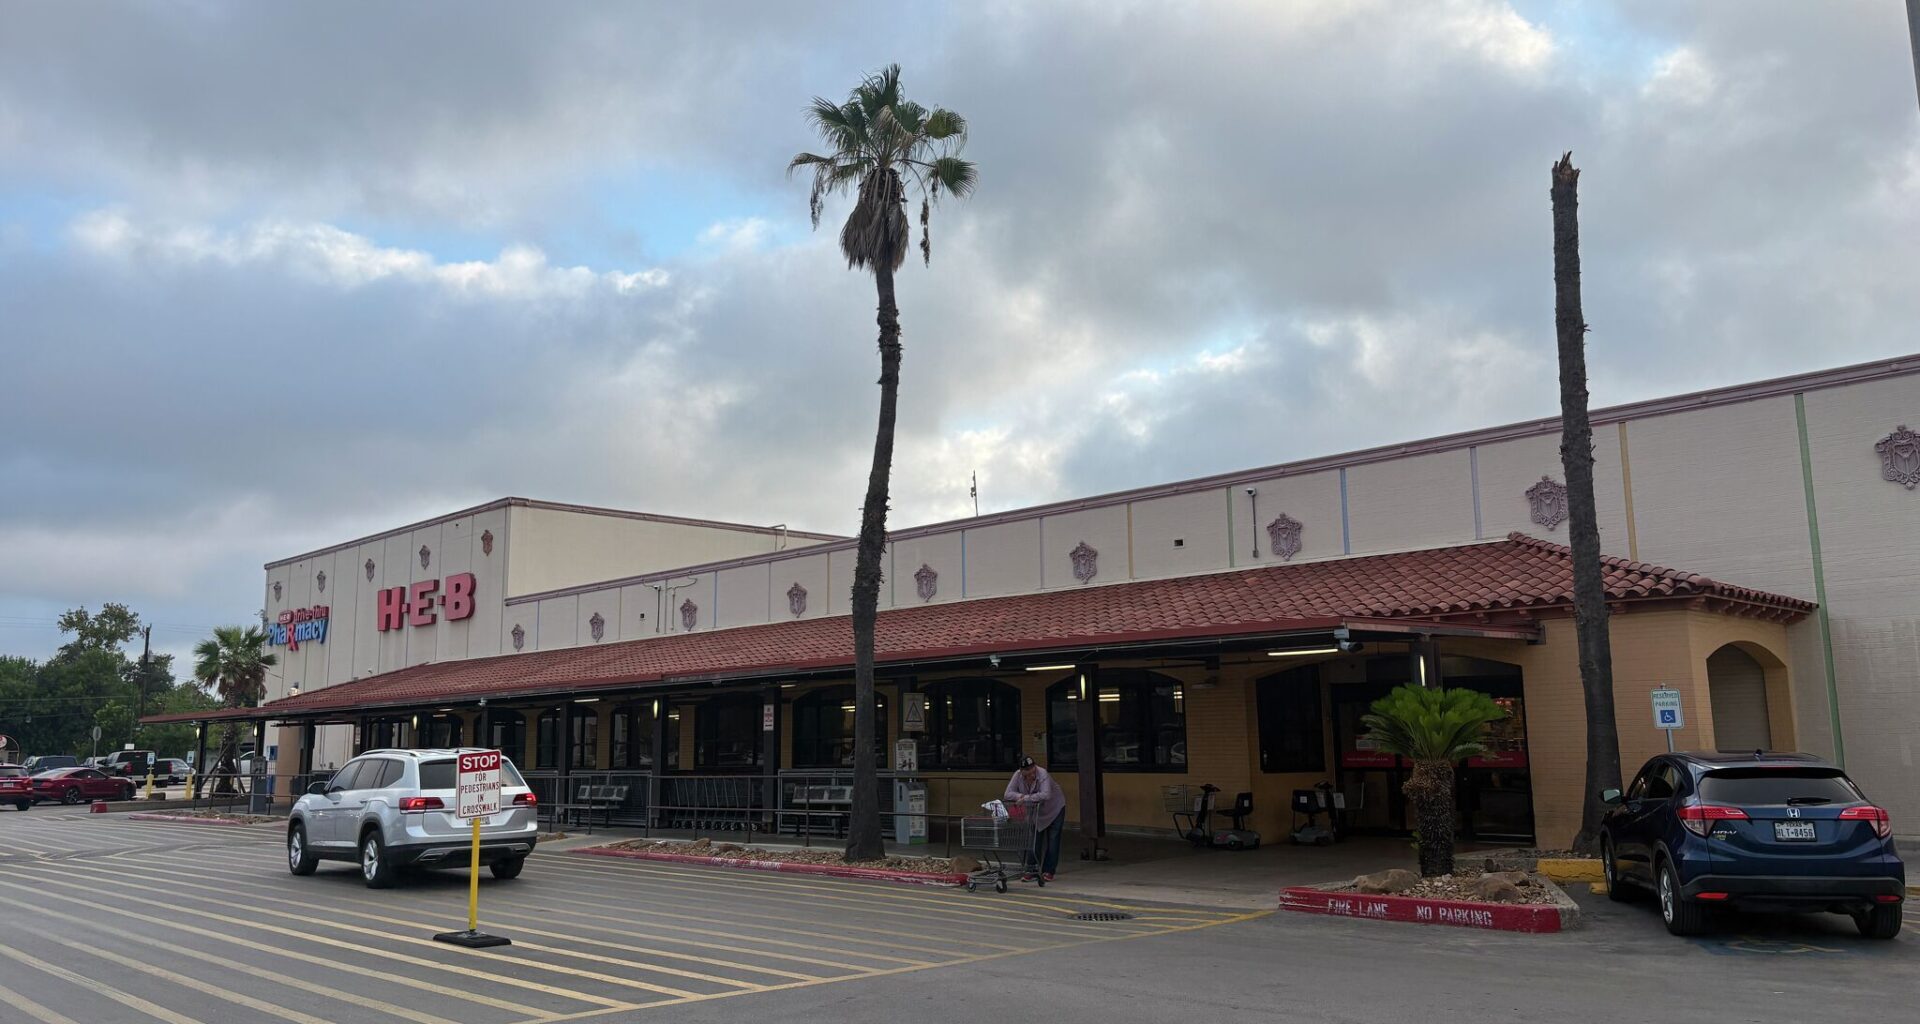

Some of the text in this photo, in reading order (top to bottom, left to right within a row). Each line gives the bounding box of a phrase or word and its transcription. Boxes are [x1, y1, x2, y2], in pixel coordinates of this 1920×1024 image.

[294, 605, 329, 623] drive-thru
[462, 754, 498, 770] STOP
[474, 773, 487, 782] FOR
[460, 781, 500, 794] PEDESTRIANS
[477, 793, 484, 803] IN
[462, 804, 497, 815] CROSSWALK
[1327, 898, 1493, 926] FIRE LANE NO PARKING
